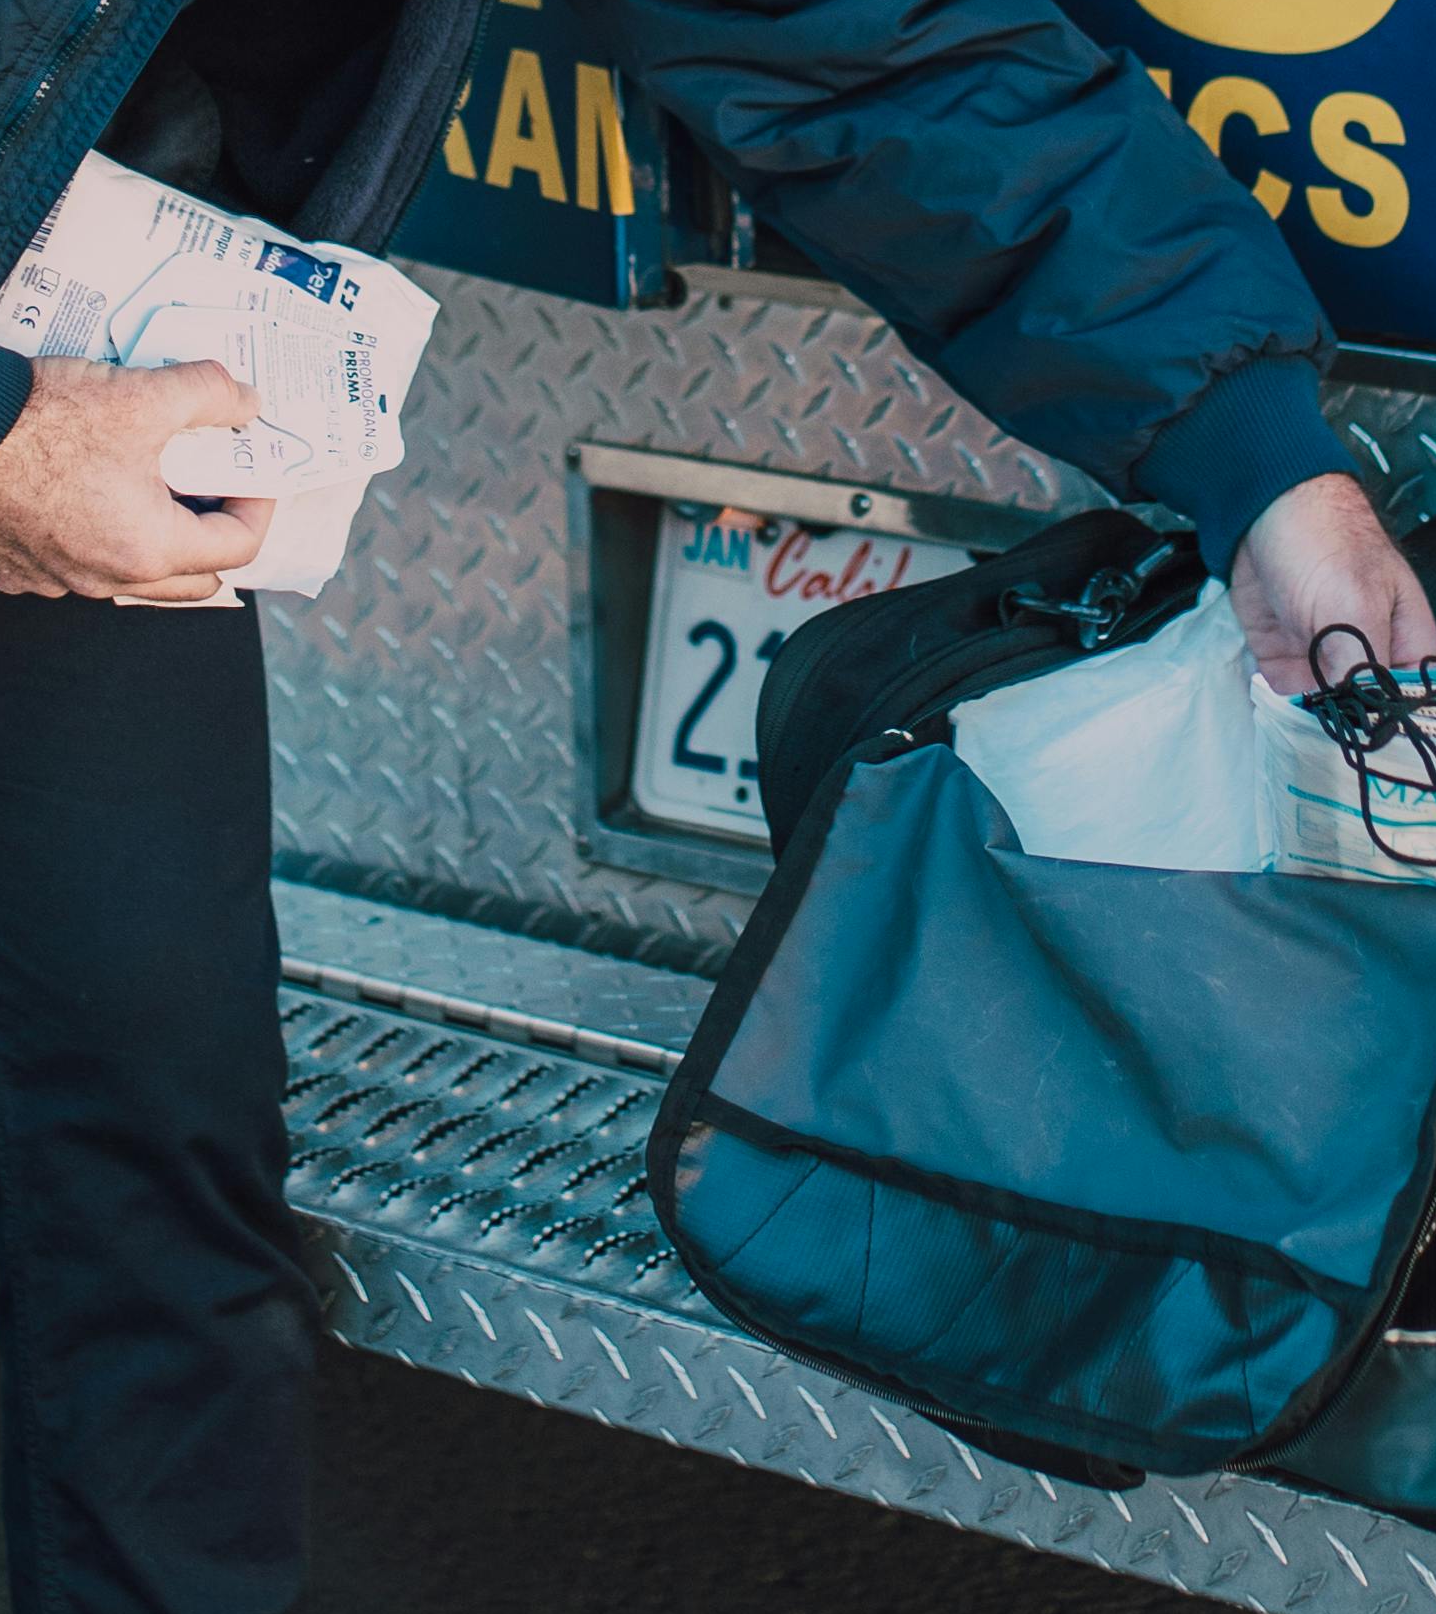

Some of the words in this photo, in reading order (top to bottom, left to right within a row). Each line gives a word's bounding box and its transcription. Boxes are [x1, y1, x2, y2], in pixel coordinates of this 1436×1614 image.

[345, 350, 361, 404] PRISMA
[358, 350, 377, 438] PROMOGRAN
[682, 522, 751, 571] JAN
